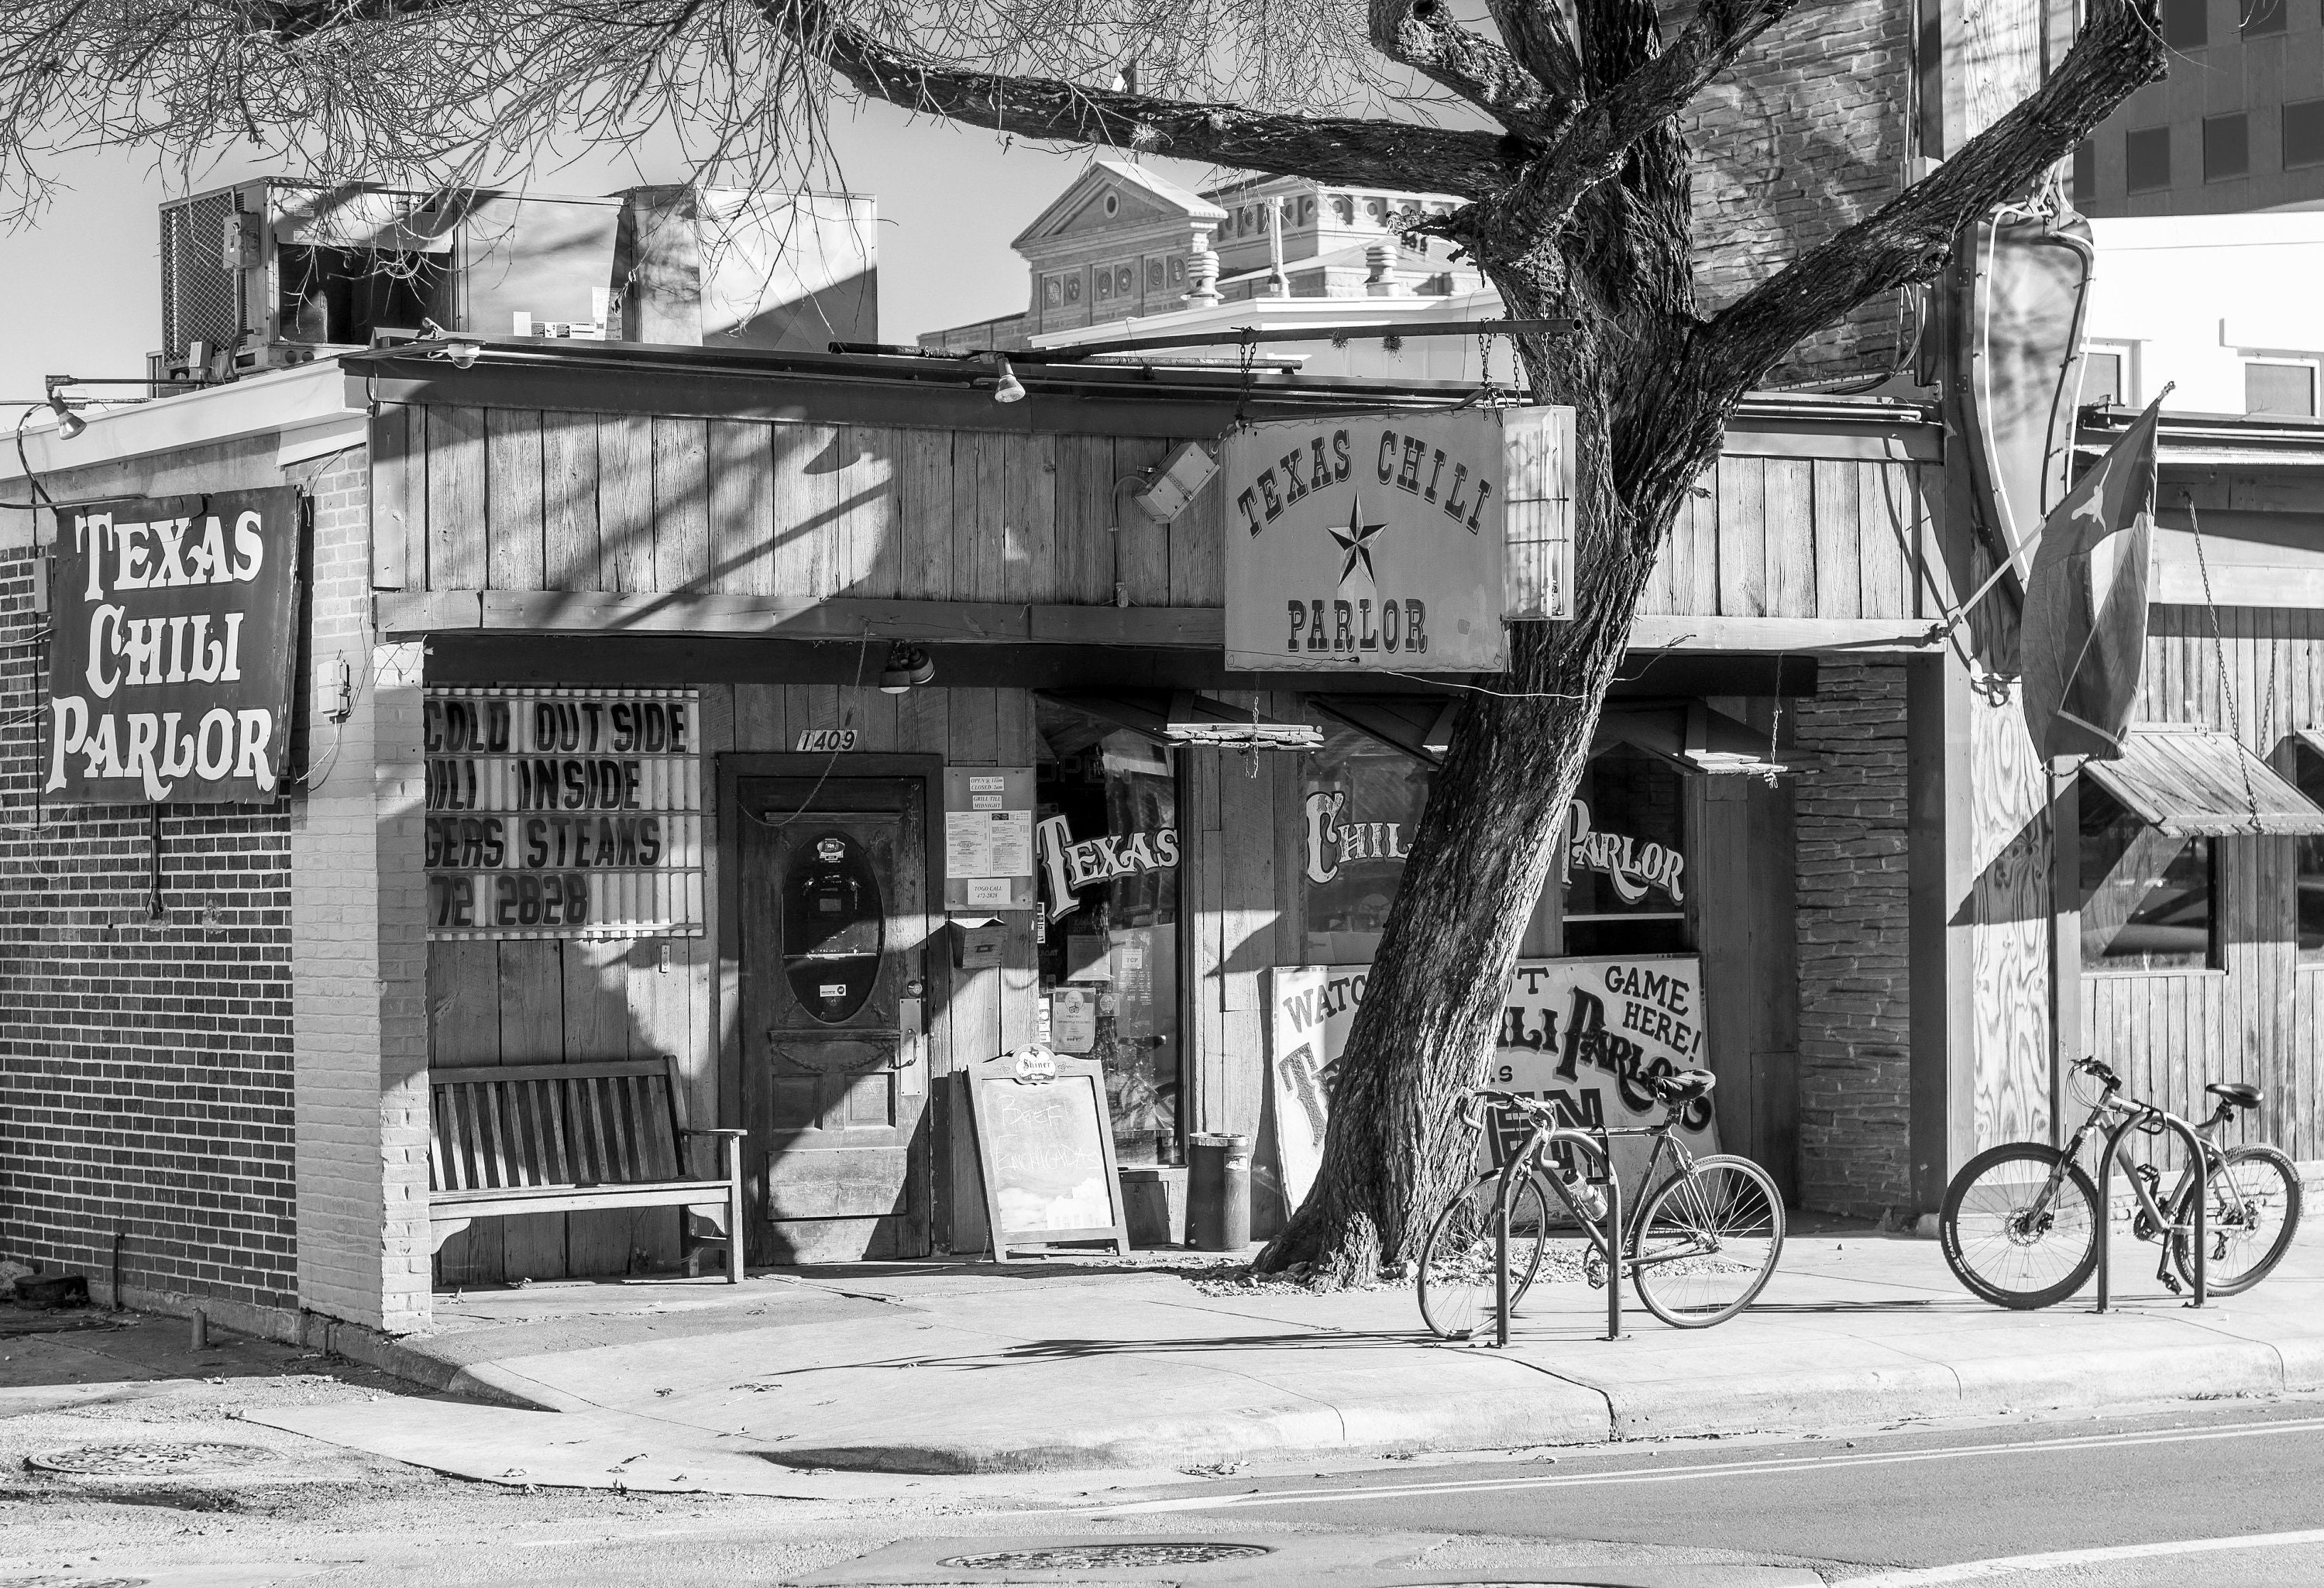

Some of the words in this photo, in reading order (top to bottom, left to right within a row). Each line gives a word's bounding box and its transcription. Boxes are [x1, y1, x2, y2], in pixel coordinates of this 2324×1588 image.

[1237, 429, 1352, 539] TEXAS
[1377, 429, 1492, 536] CHILI
[75, 511, 263, 602] TEXAS
[85, 603, 244, 699] CHILI
[1287, 599, 1428, 654] PARLOR
[45, 696, 276, 801] PARLOR
[424, 701, 510, 752] COLD
[798, 730, 855, 751] 1409
[520, 760, 640, 809] INSIDE
[526, 817, 661, 868] STEAKS
[1306, 791, 1415, 884] CHIL
[1560, 799, 1684, 904] PARLOR
[1037, 815, 1179, 922] TEXAS
[497, 875, 588, 926] 2828
[1283, 974, 1367, 1033] WATC
[1604, 965, 1691, 1016] GAME
[1622, 1001, 1702, 1063] HERE!
[1023, 1058, 1051, 1071] Shiner
